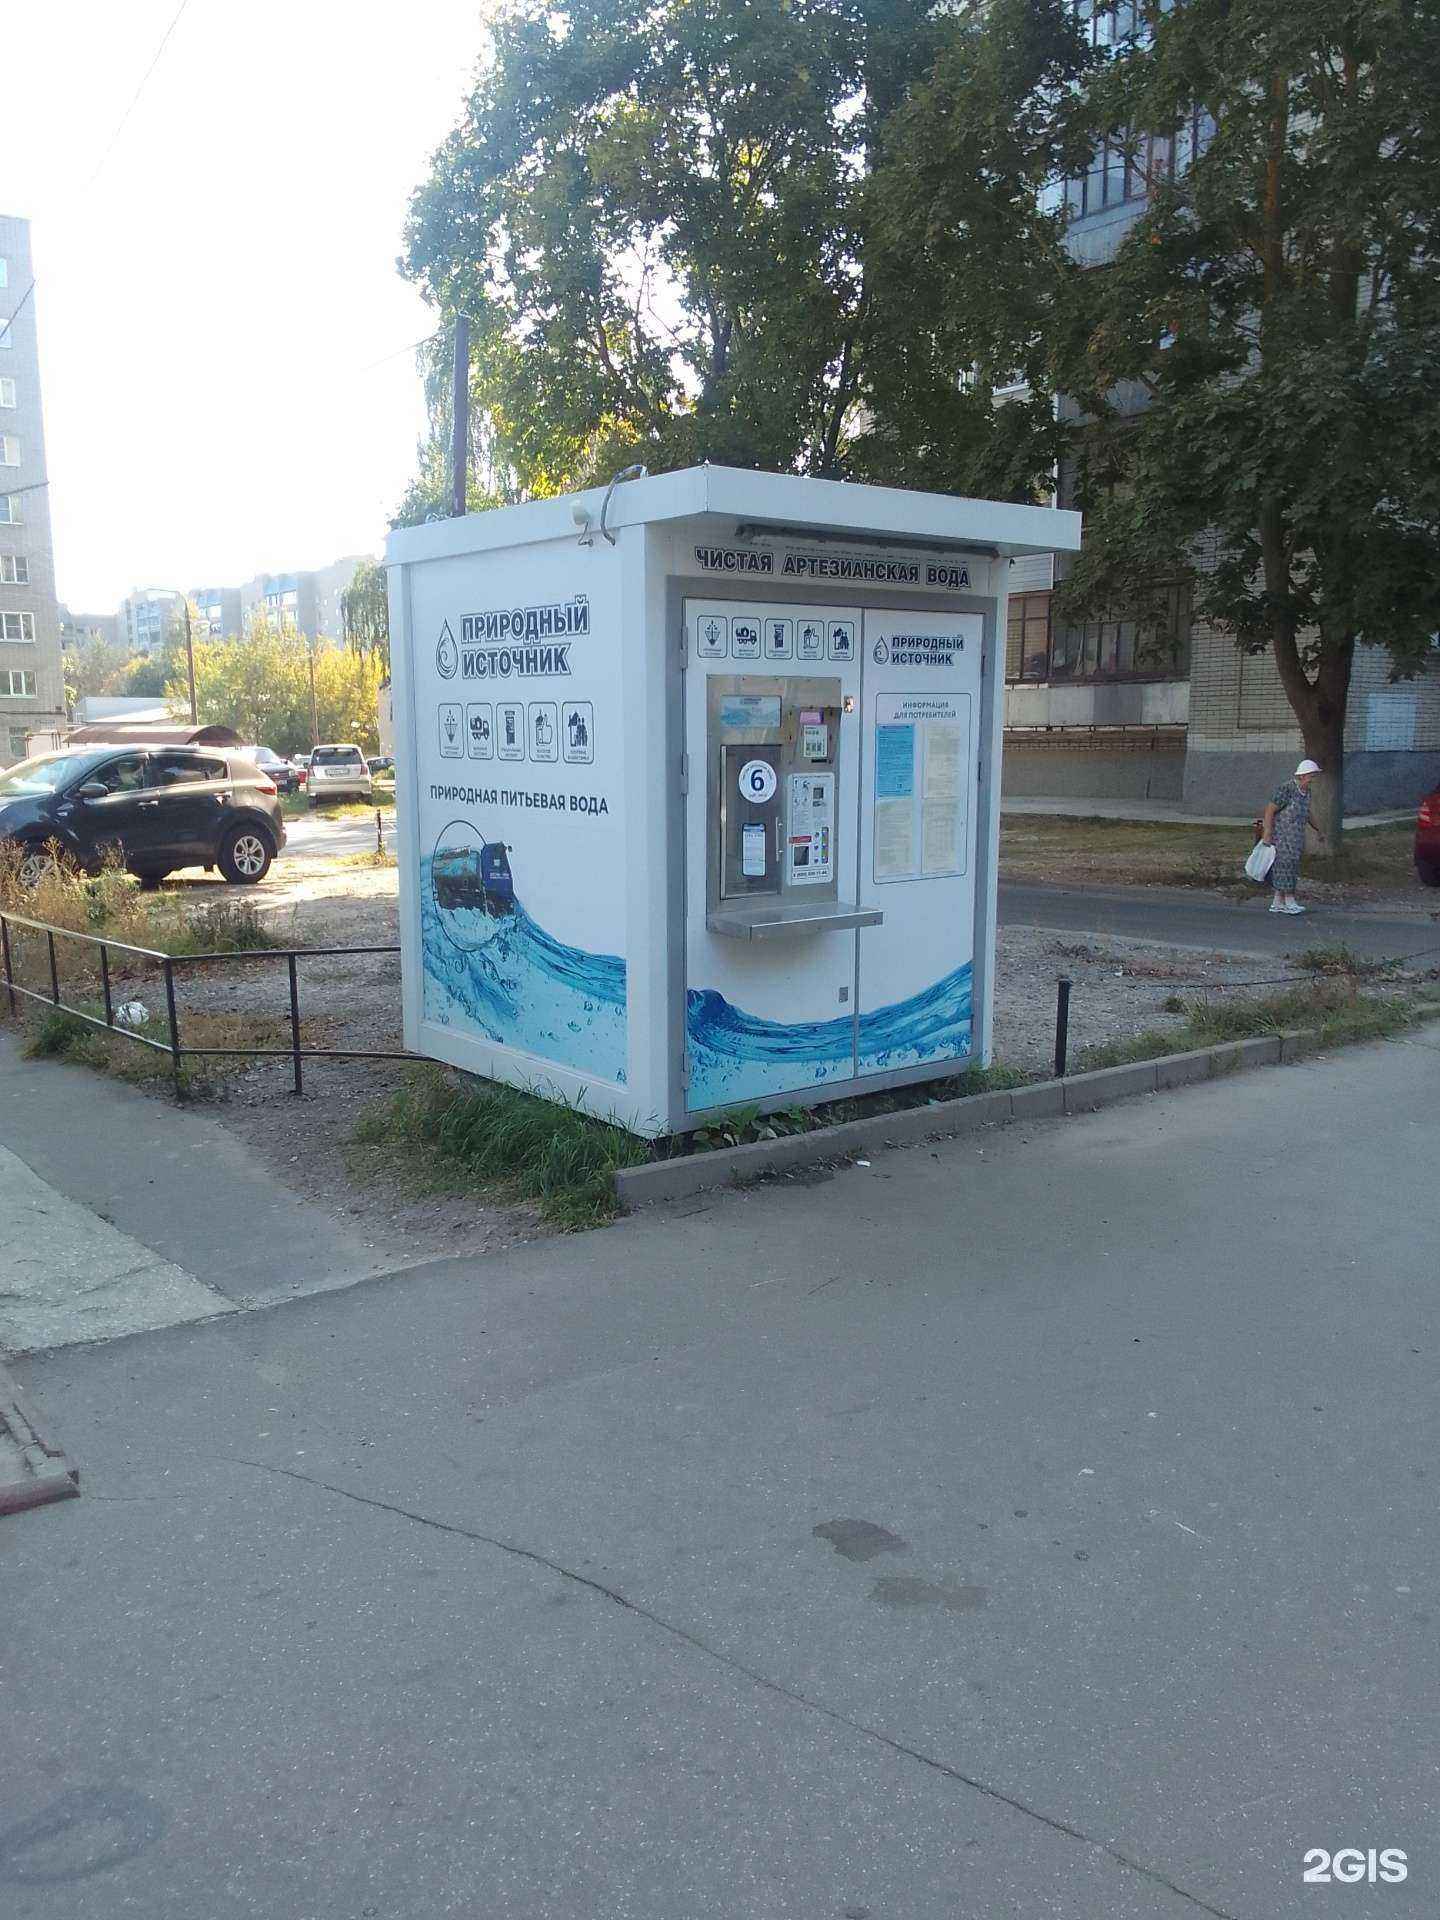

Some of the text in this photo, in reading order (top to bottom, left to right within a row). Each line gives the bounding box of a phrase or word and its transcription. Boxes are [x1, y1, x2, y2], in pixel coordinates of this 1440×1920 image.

[695, 546, 971, 590] ЧИСТАЯ АРТЕЗИАНСКАЯ ВОДА
[461, 595, 589, 644] ПРИРОДНЫЙ
[891, 635, 965, 651] ПРИРОДНЫЙ
[461, 643, 571, 679] ИСТОЧНИК
[891, 652, 954, 666] ИСТОЧНИК
[902, 701, 949, 709] ИНФОРМАЦИЯ
[908, 710, 956, 719] ПОТРЕБИТЕЛЕЙ
[750, 769, 765, 791] 6
[430, 785, 609, 816] ПРИРОДНАЯ ПИТЬЕВАЯ ВОДА
